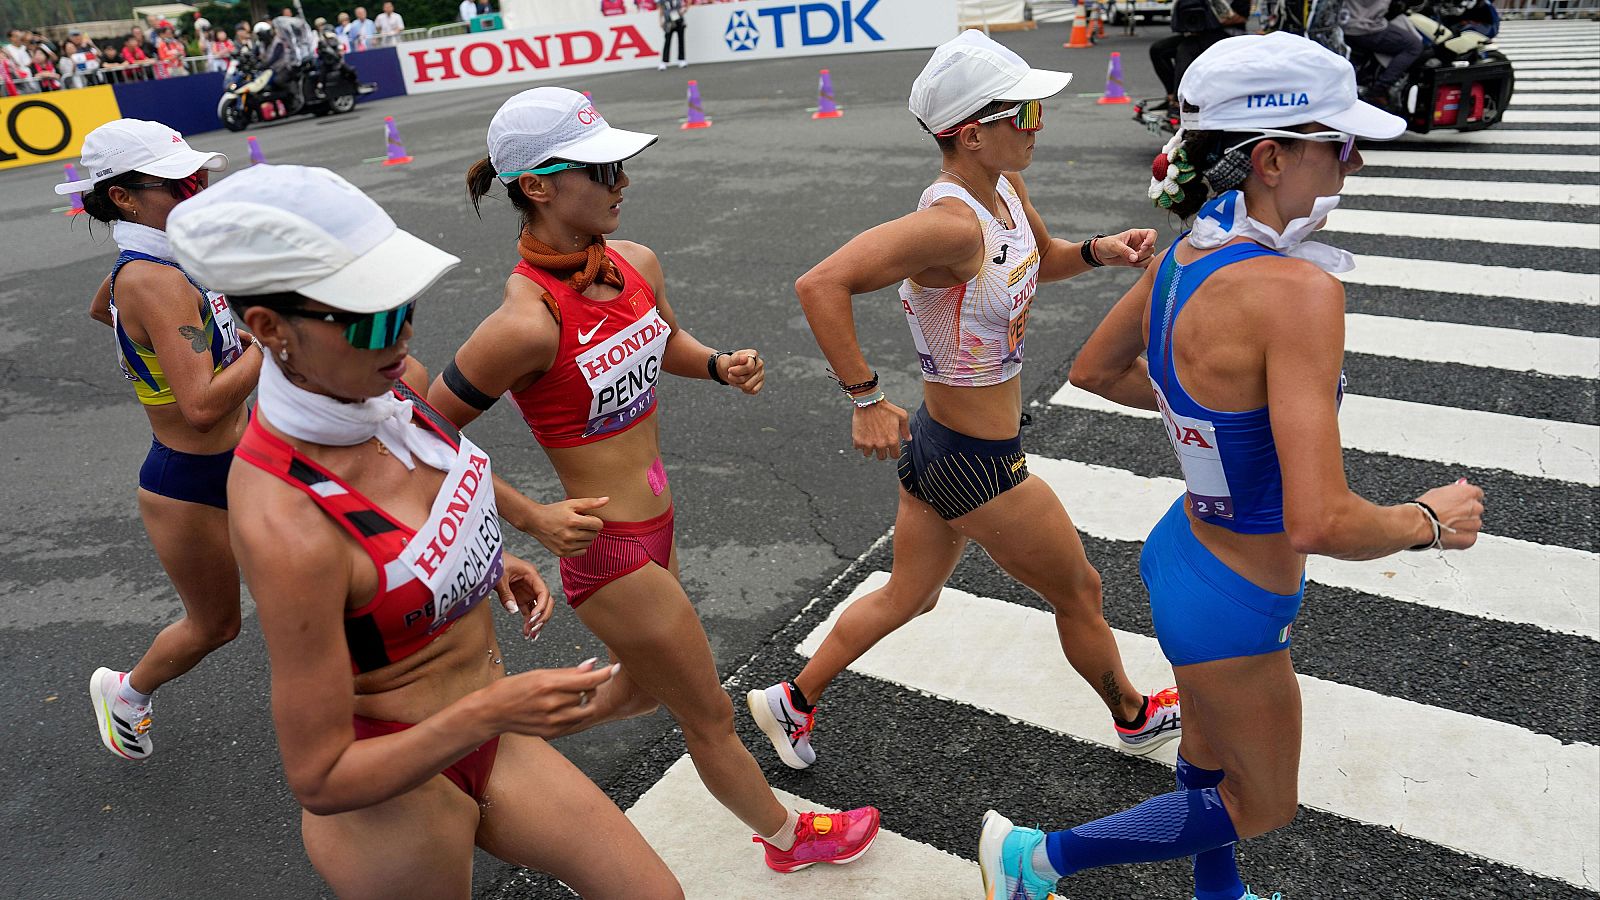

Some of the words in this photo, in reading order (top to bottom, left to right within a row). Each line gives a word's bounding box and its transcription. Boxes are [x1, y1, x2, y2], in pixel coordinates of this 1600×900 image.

[758, 0, 884, 48] TDK
[408, 25, 659, 84] HONDA
[1247, 93, 1309, 108] ITALIA
[583, 318, 668, 381] HONDA
[597, 356, 658, 415] PENG
[414, 454, 488, 581] HONDA
